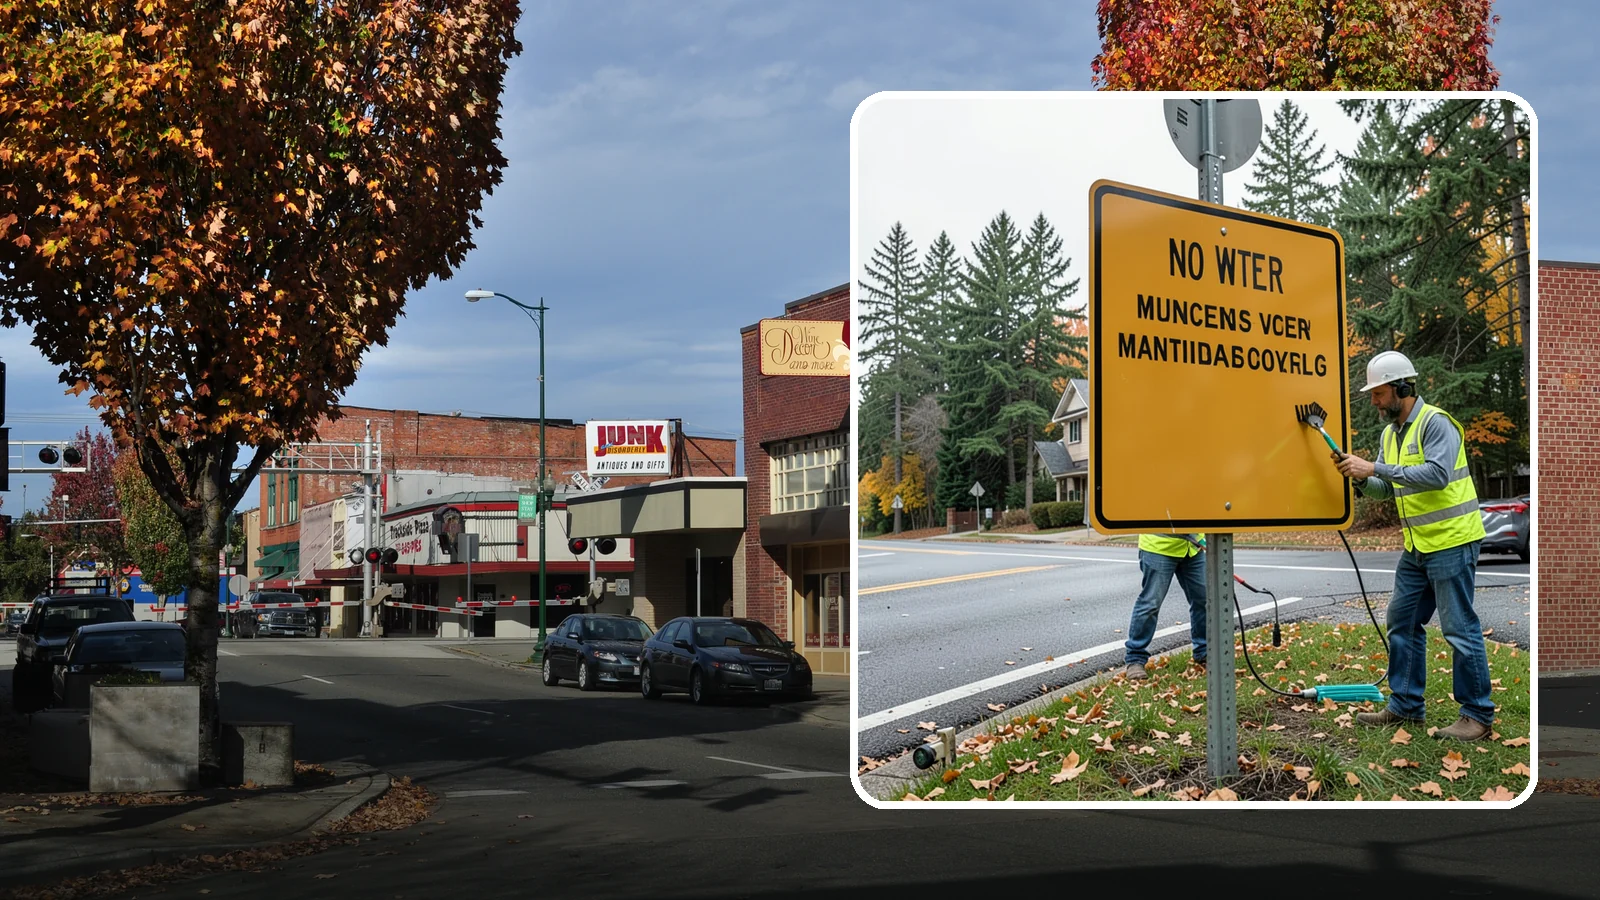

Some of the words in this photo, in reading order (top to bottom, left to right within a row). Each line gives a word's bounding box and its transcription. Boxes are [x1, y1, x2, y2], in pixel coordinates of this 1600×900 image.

[1169, 237, 1204, 281] NO
[1215, 245, 1284, 294] WTER
[1137, 294, 1252, 333] MUNCENS
[595, 425, 665, 457] JUNK
[607, 446, 646, 454] DISORDERLY
[597, 461, 628, 470] ANTIQUES
[631, 461, 644, 469] AND
[647, 460, 665, 469] GIFTS
[573, 473, 589, 492] RAIL
[390, 521, 413, 540] Trackside
[414, 519, 429, 534] Pizza
